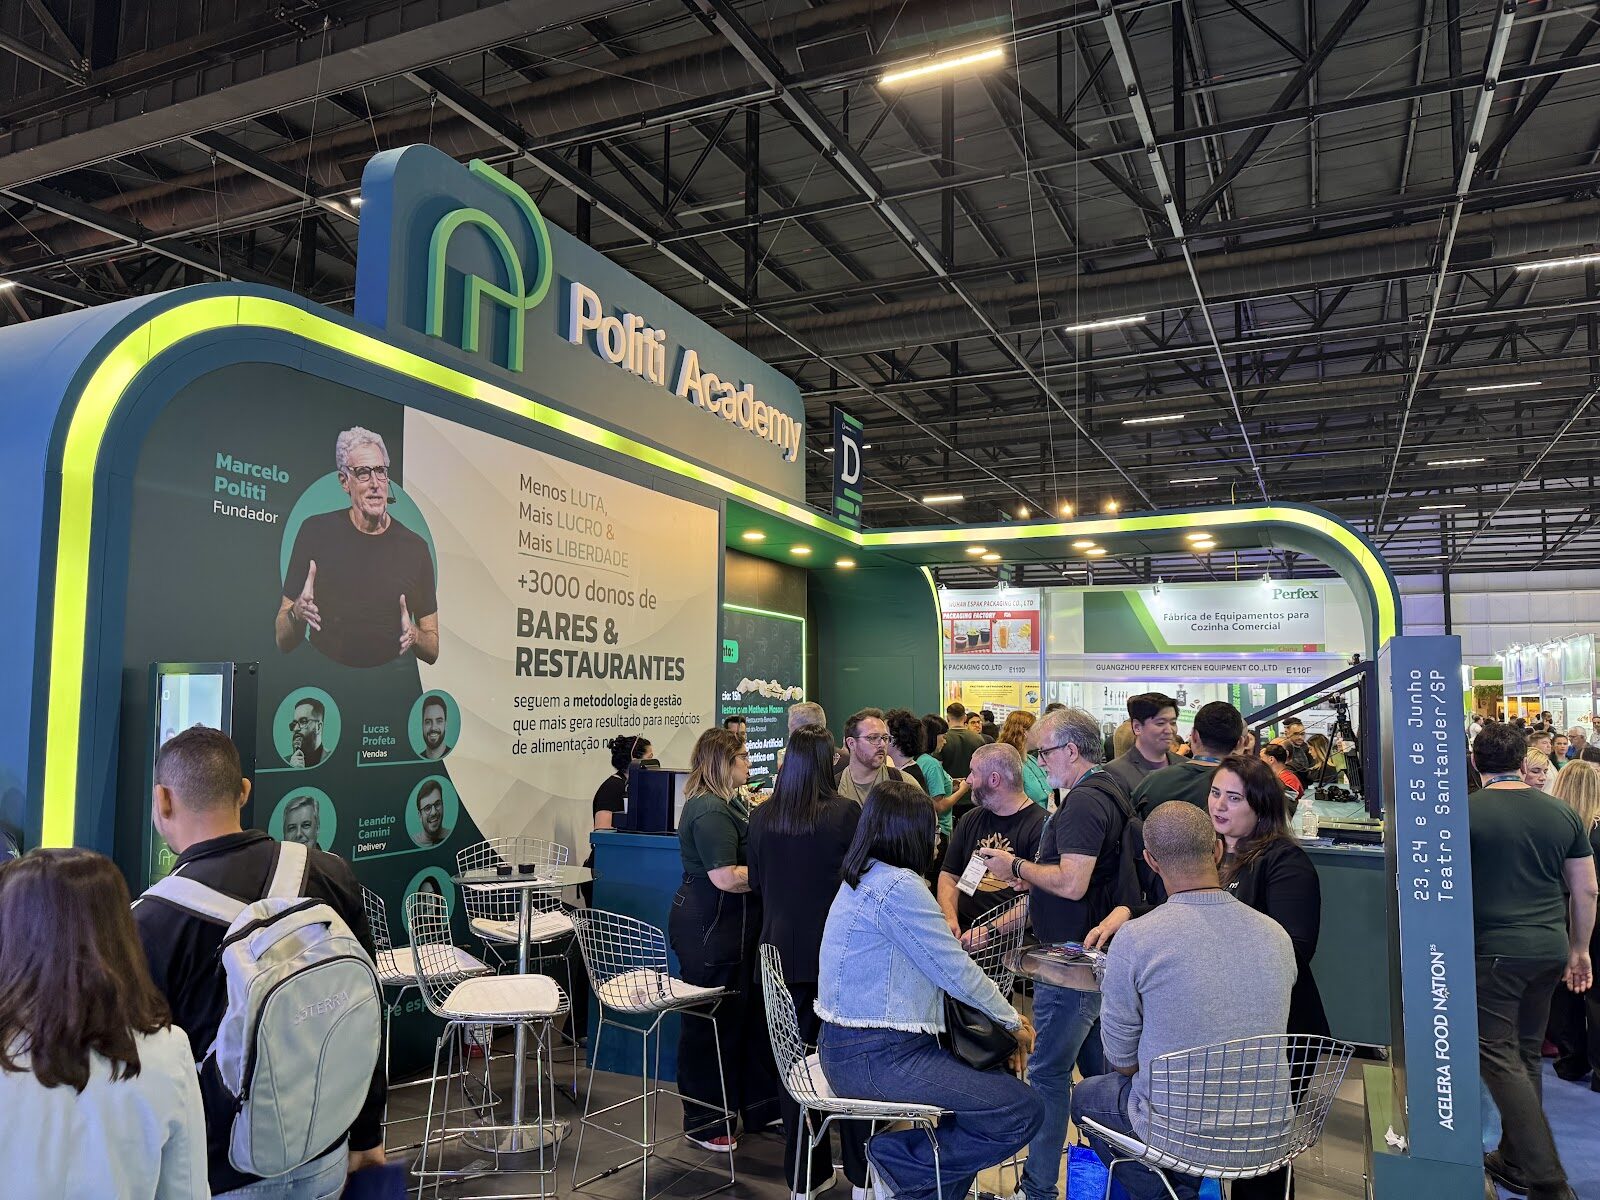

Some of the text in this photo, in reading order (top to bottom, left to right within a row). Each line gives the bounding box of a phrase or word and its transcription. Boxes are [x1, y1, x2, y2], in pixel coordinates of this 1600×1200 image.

[569, 282, 802, 463] Politi Academy
[216, 452, 289, 483] Marcelo
[841, 434, 860, 485] D
[215, 476, 266, 501] Politi
[520, 474, 609, 516] Menos LUTA,
[213, 500, 278, 523] Fundador
[519, 501, 615, 540] Mais LUCRO &
[518, 530, 629, 569] Mais LIBERDADE
[518, 570, 657, 610] +3000 donos de
[1272, 588, 1319, 600] Perfex
[517, 607, 618, 645] BARES &
[1163, 612, 1309, 622] Fábrica de Equipamentos para
[1191, 622, 1281, 631] Cozinha Comercial
[515, 647, 685, 681] RESTAURANTES
[1248, 664, 1278, 672] CO.,LTD
[514, 693, 682, 711] seguem a metodologia de gestão
[363, 724, 389, 734] Lucas
[513, 712, 700, 735] que mais gera resultado para negócios
[362, 736, 396, 746] Profeta
[512, 739, 527, 755] de
[530, 737, 599, 755] alimentação
[362, 750, 388, 758] Vendas
[1407, 670, 1430, 901] 23,24 e 25 de Junho
[1430, 669, 1453, 901] Teatro Santander/SP
[358, 826, 390, 839] Camini
[359, 815, 396, 827] Leandro
[357, 842, 387, 852] Delivery
[1433, 1014, 1450, 1060] FOOD
[1438, 1065, 1454, 1130] ACELERA
